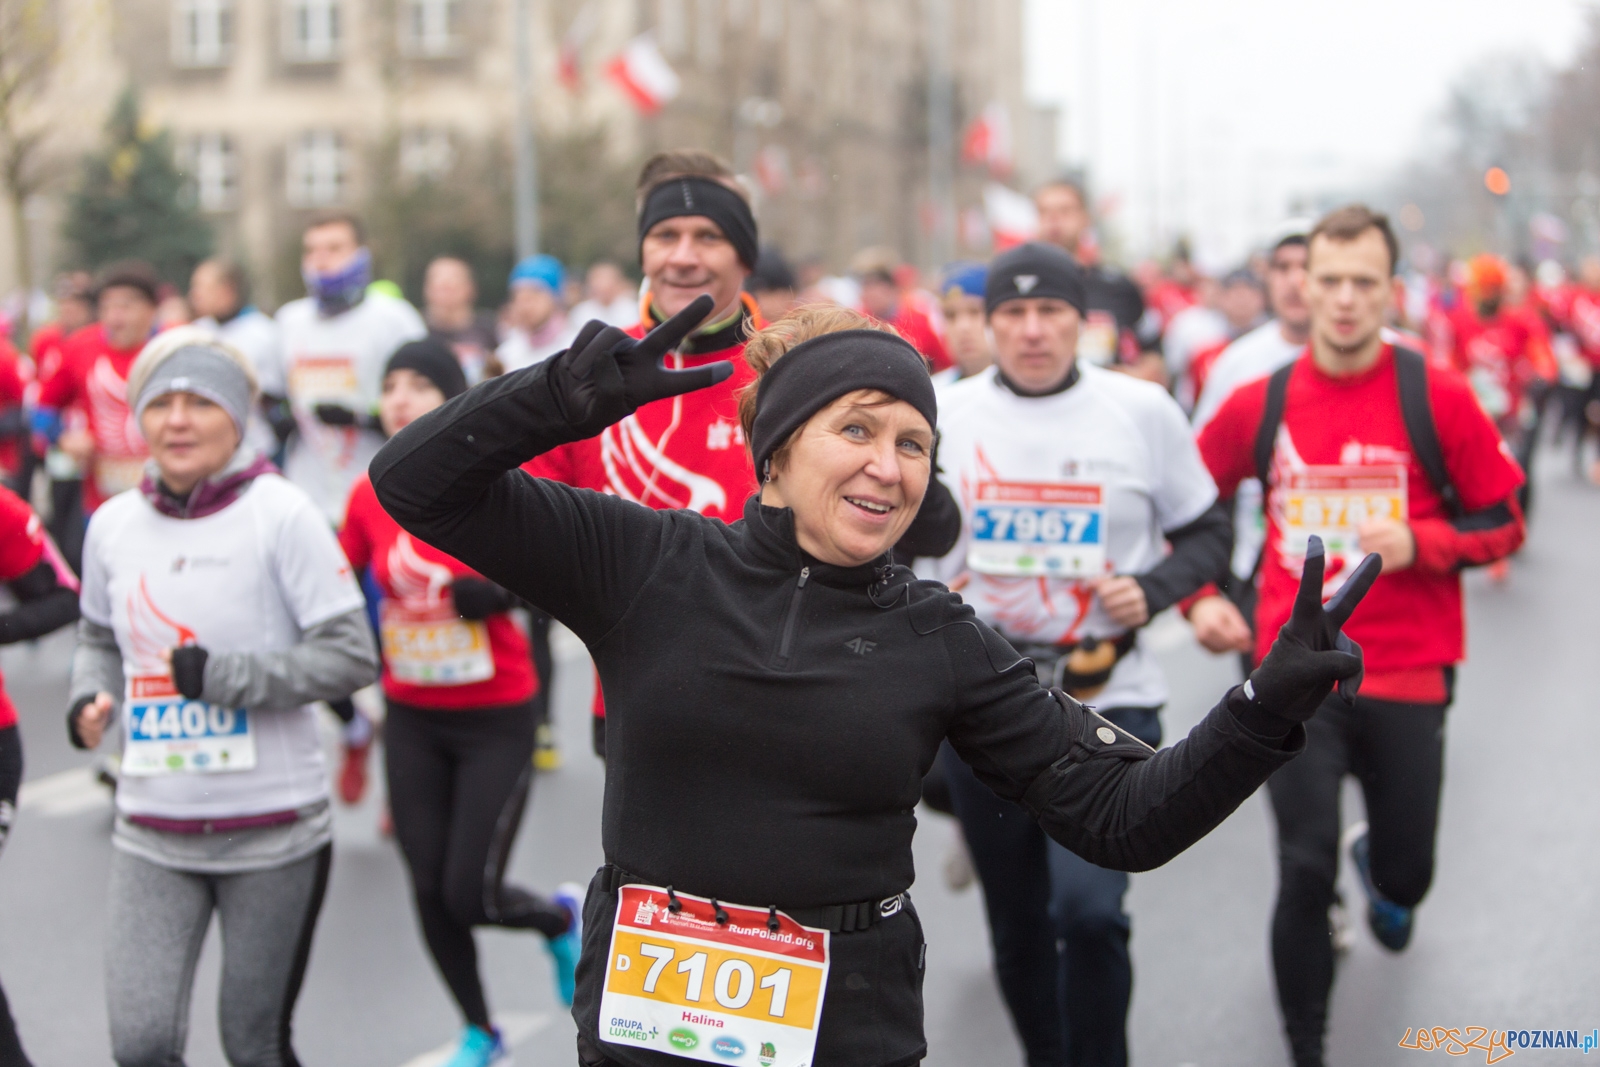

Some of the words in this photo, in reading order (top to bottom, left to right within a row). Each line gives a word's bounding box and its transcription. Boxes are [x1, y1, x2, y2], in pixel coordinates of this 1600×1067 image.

[988, 508, 1092, 543] 7967
[844, 637, 878, 655] 4F
[140, 701, 235, 739] 4400
[728, 924, 815, 951] RunPoland.org
[616, 953, 632, 972] D
[640, 942, 792, 1018] 7101
[611, 1017, 644, 1031] GRUPA
[682, 1011, 725, 1029] Halina
[609, 1027, 648, 1042] LUXMED
